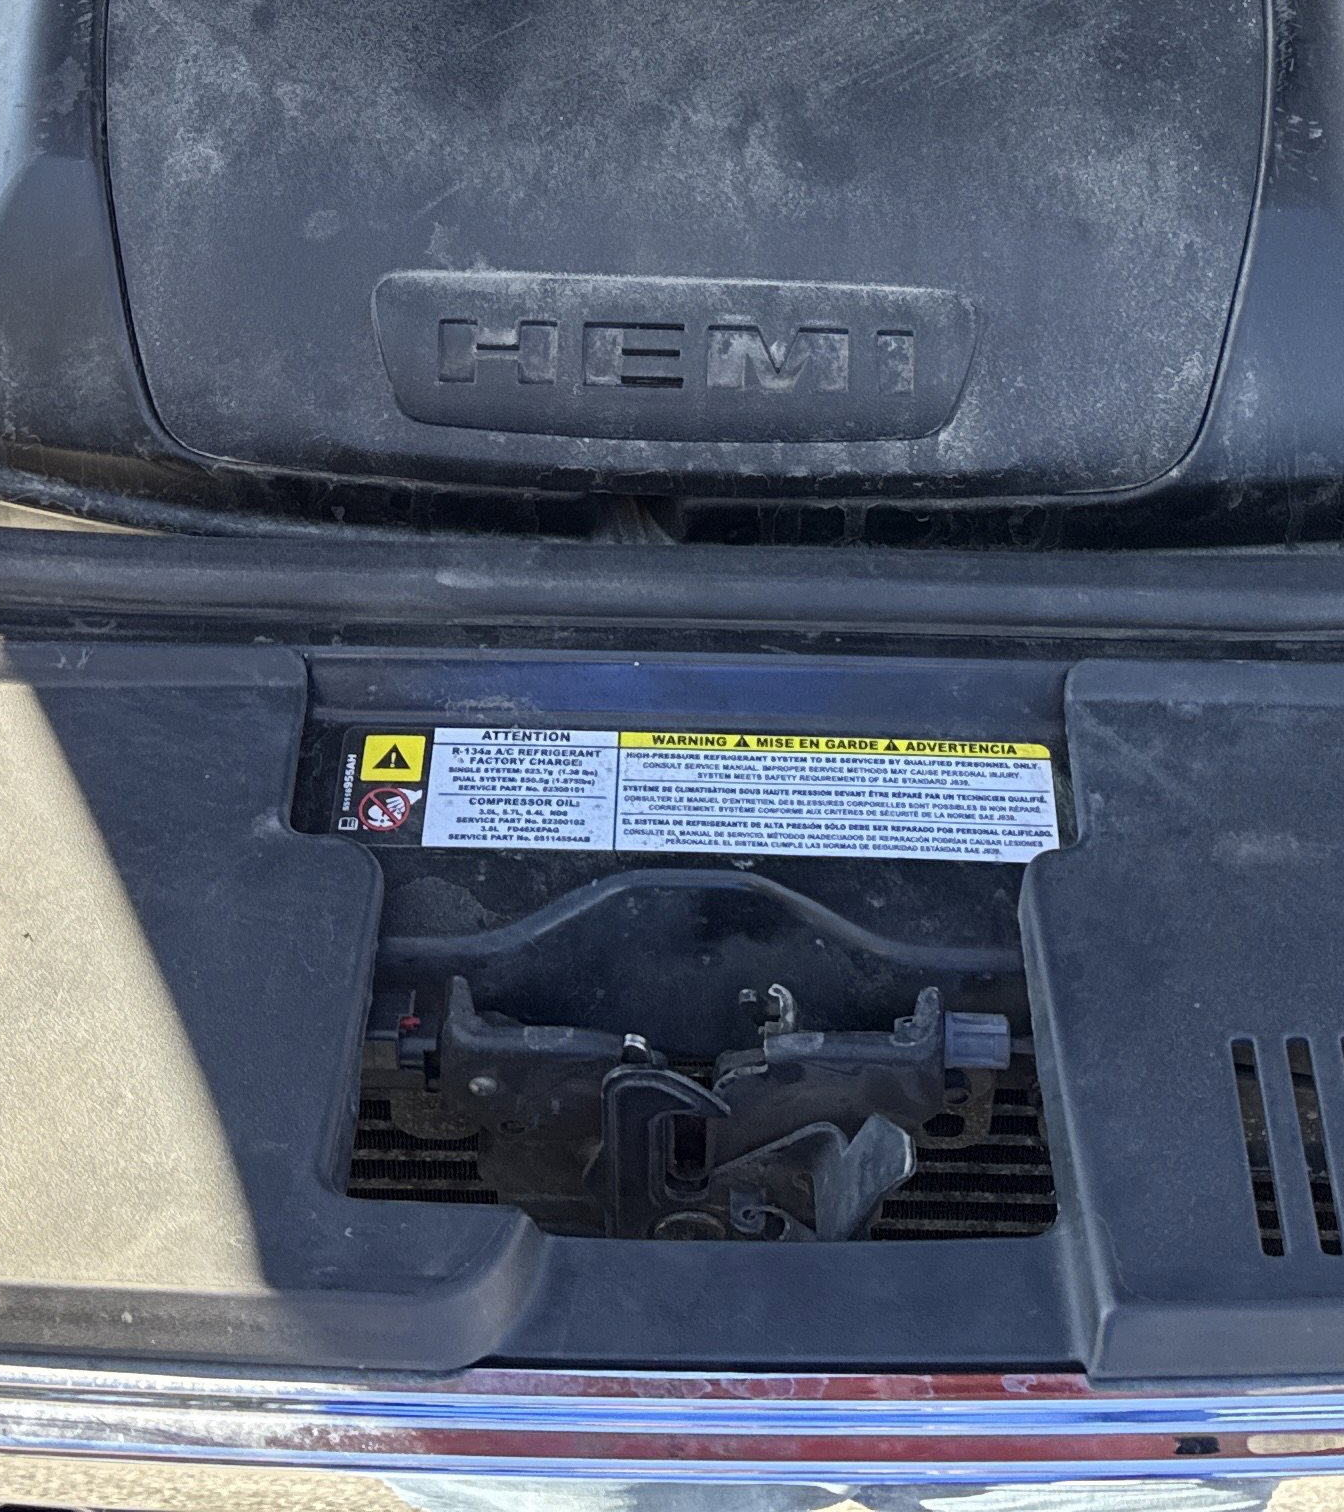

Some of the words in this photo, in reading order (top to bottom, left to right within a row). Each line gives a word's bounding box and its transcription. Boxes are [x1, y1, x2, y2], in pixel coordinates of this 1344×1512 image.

[436, 317, 915, 394] HEMI
[481, 730, 571, 742] ATTENTION
[652, 735, 727, 747] WARNING
[756, 737, 794, 748] MISE
[799, 738, 820, 749] EN
[825, 739, 878, 750] GARDE
[905, 742, 1018, 754] ADVERTENCIA
[452, 747, 492, 756] R-134a
[494, 748, 514, 756] A/C
[518, 748, 602, 757] REFRIGERANT
[469, 757, 525, 765] FACTORY
[468, 797, 552, 806] COMPRESSOR
